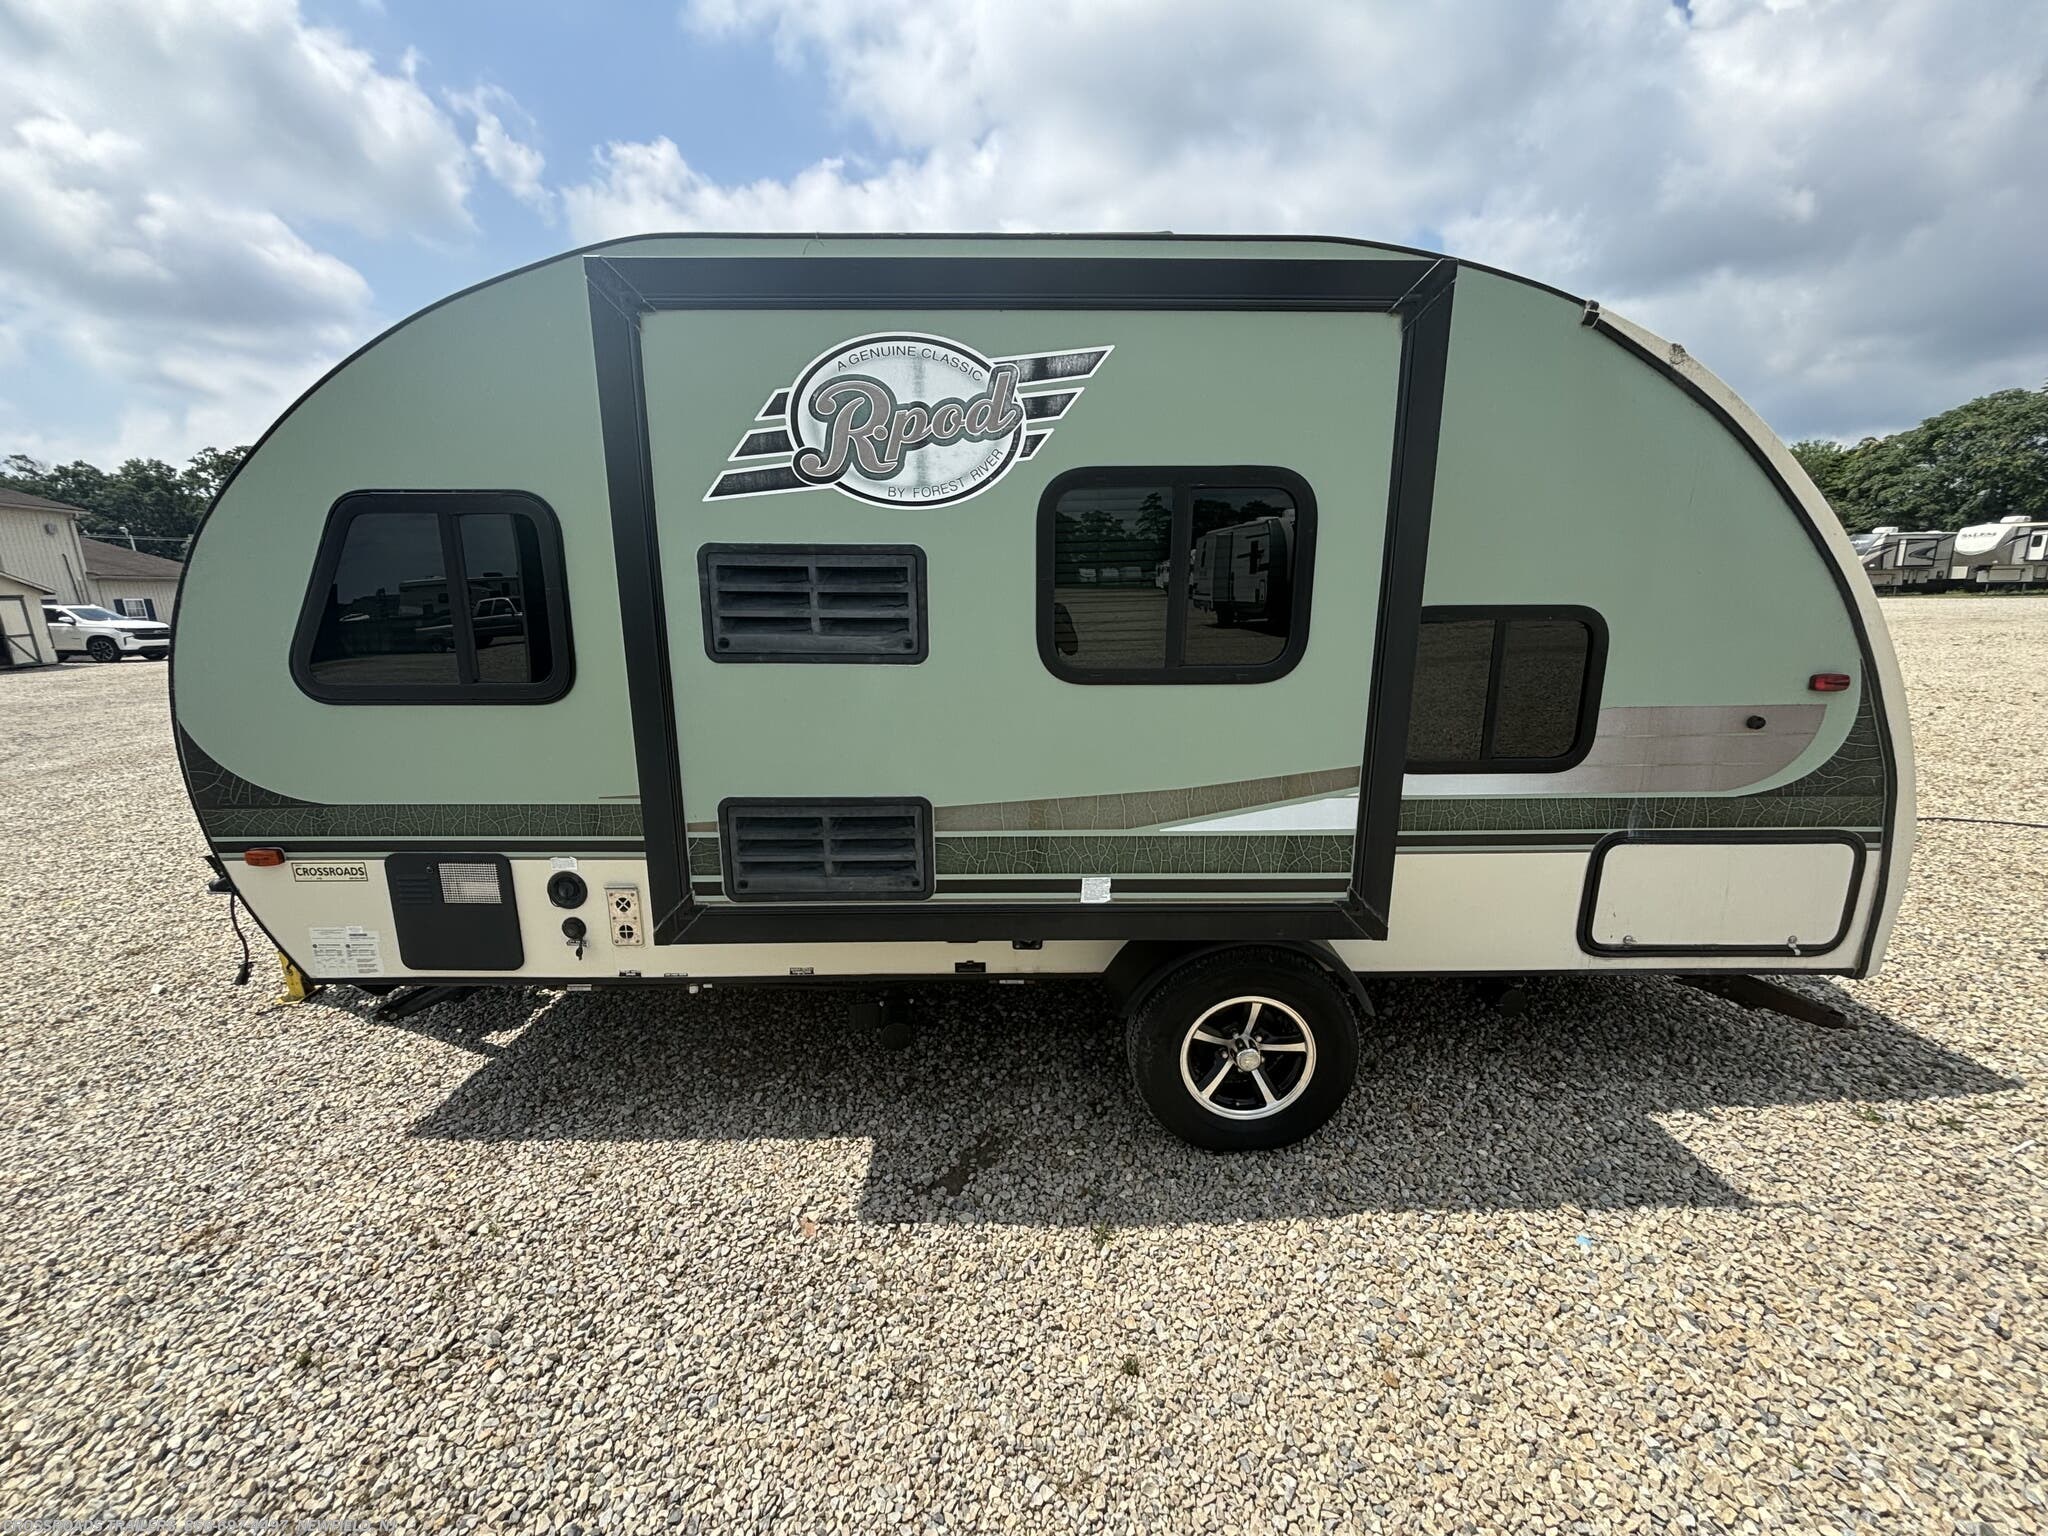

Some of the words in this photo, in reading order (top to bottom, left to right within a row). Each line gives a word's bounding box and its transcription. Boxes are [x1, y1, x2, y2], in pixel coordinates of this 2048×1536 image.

[836, 360, 847, 371] A
[848, 345, 917, 365] GENUINE
[921, 348, 983, 381] CLASSIC
[887, 486, 906, 498] BY
[912, 477, 965, 498] FOREST
[969, 448, 1004, 480] RIVER
[295, 866, 365, 876] CROSSROADS
